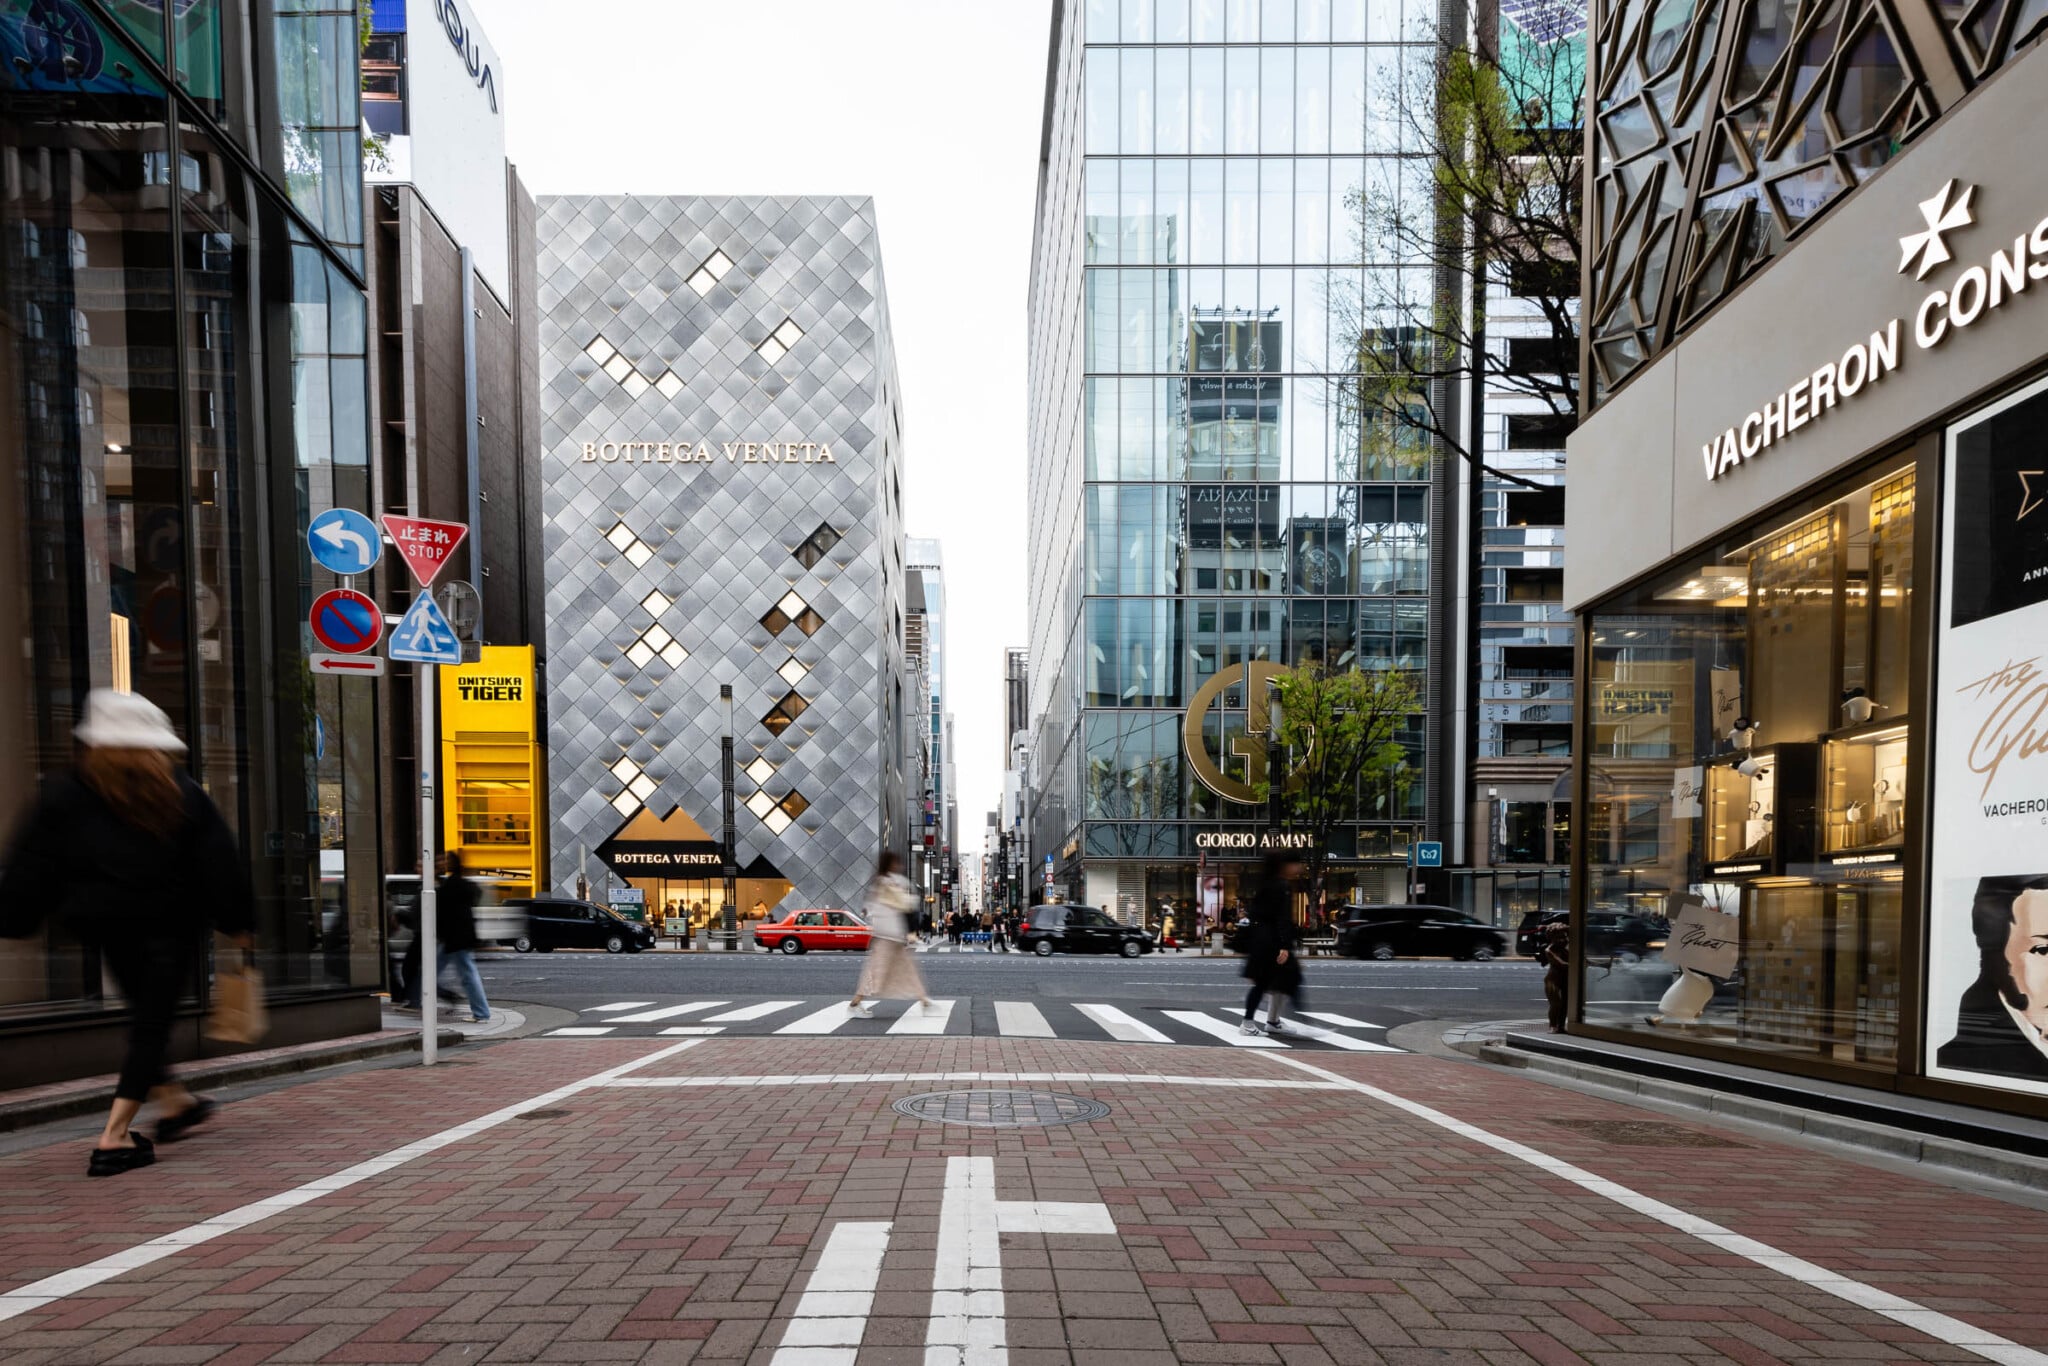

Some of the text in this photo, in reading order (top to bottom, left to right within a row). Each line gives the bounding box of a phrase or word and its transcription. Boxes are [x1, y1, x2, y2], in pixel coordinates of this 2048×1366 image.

[1702, 318, 1901, 481] VACHERON
[582, 442, 836, 464] BOTTEGA VENETA
[400, 525, 451, 544] 止まれ
[408, 544, 444, 559] STOP
[458, 676, 522, 686] ONITSUKA
[458, 686, 522, 701] TIGER
[1984, 798, 2048, 818] VACHERO
[1196, 833, 1256, 848] GIORGIO
[614, 854, 722, 864] BOTTEGA VENETA
